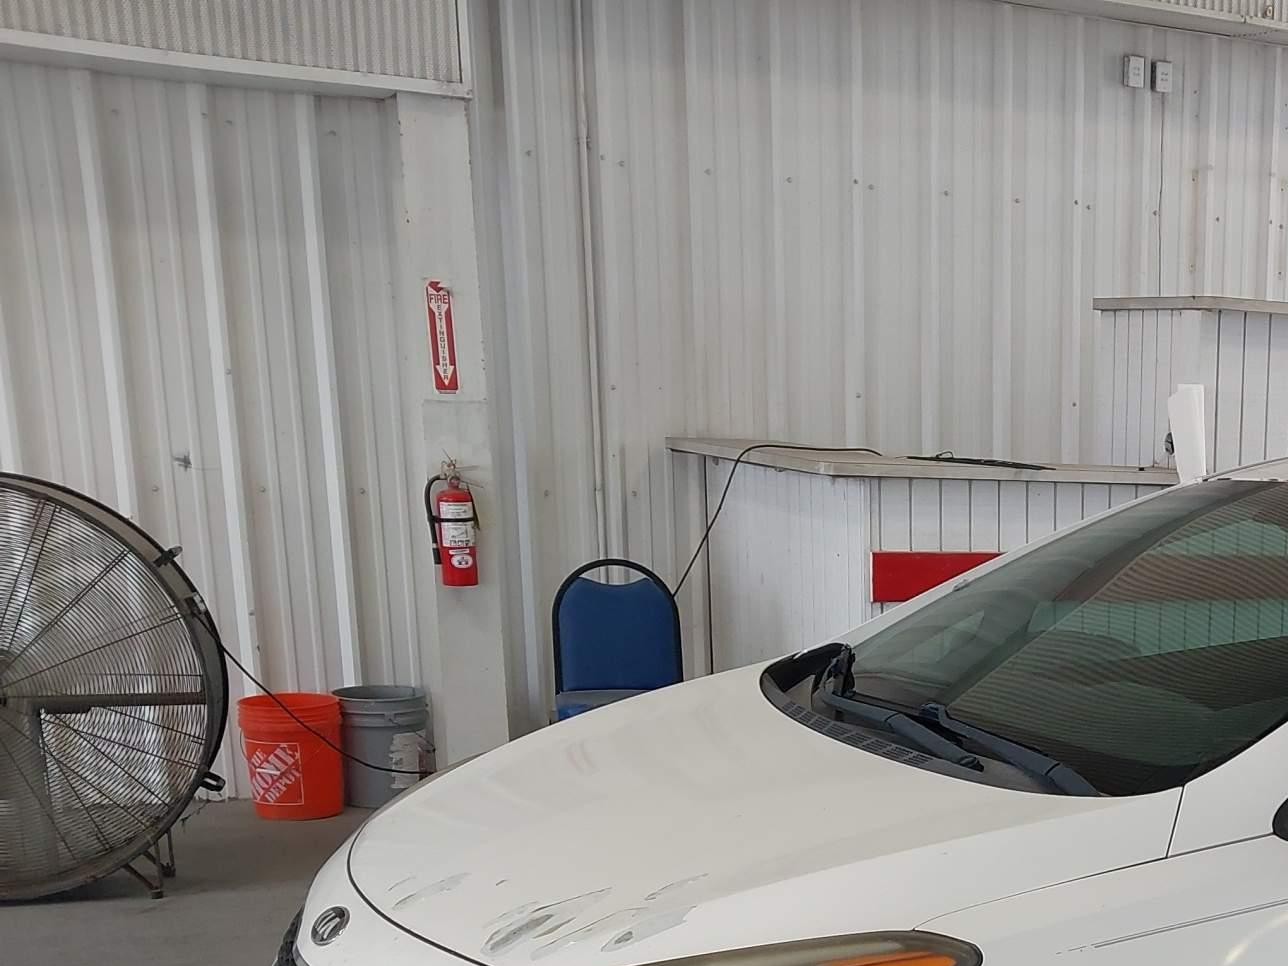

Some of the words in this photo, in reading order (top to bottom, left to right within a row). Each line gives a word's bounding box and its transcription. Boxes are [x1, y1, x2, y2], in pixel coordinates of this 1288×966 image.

[428, 293, 449, 305] FIRE
[437, 304, 449, 380] EXTINGUISHER
[249, 748, 267, 774] THE
[250, 744, 299, 801] HOME
[264, 765, 301, 803] DEPOT
